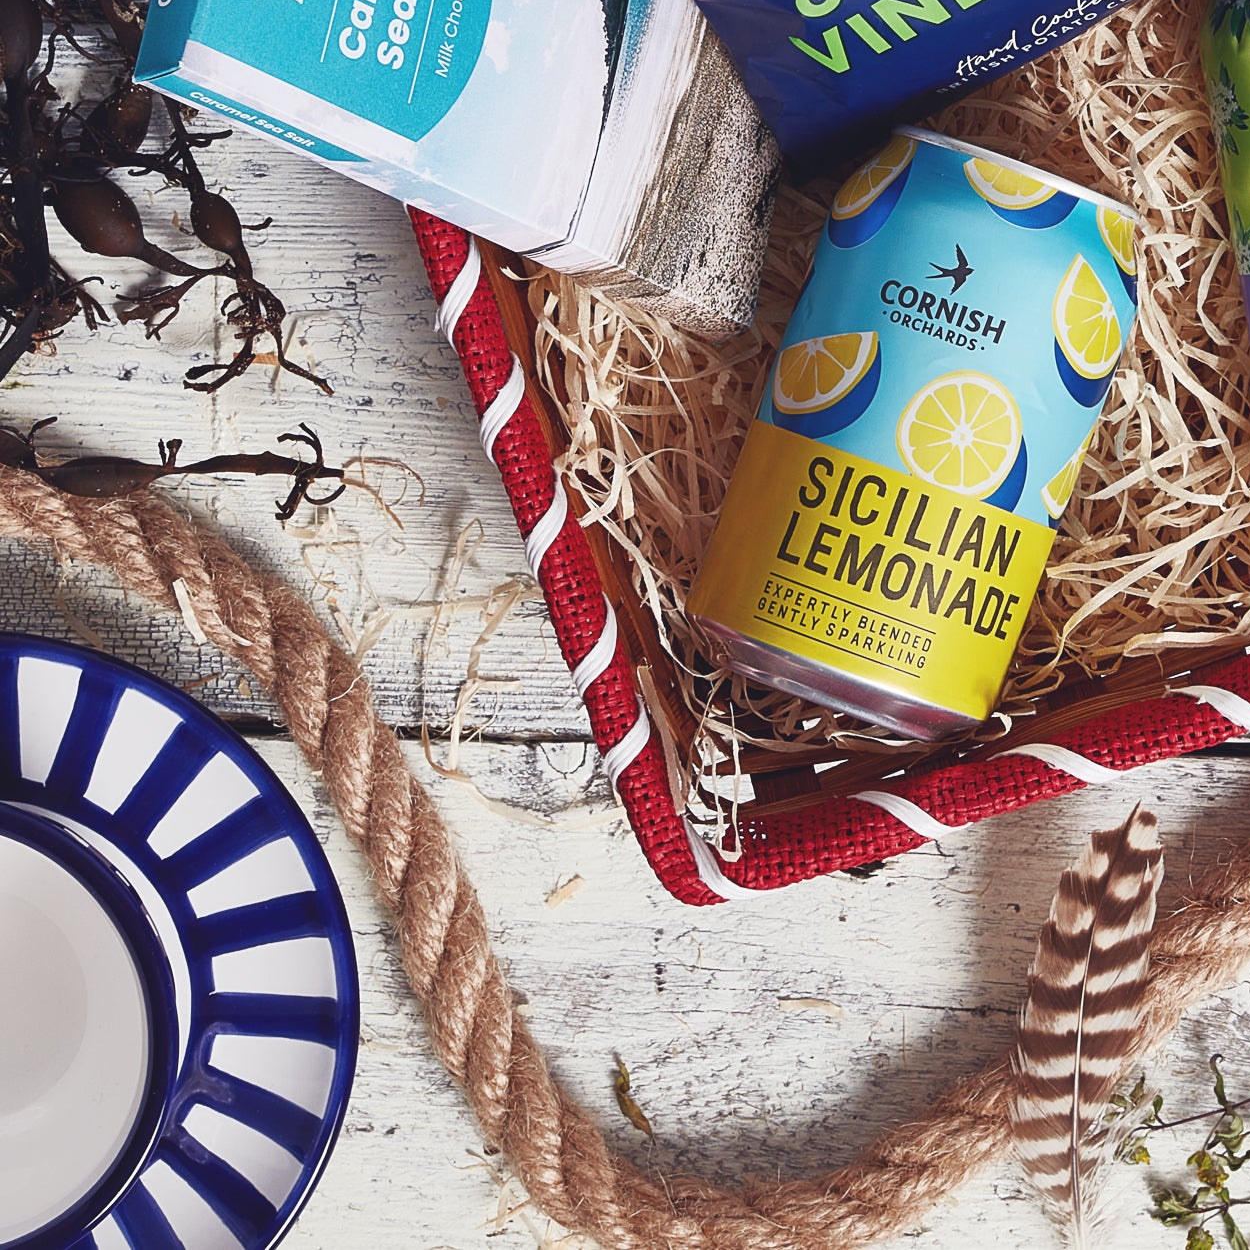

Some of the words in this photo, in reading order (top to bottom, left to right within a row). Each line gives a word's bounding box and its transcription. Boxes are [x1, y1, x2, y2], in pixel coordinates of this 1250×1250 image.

[434, 41, 455, 78] Milk
[955, 30, 1020, 76] Hand
[1021, 12, 1098, 52] POTATO
[189, 91, 257, 122] Caramel
[254, 119, 285, 134] Sea
[283, 131, 316, 148] Salt
[880, 280, 1006, 344] CORNISH
[798, 456, 1022, 577] SICILIAN
[776, 510, 1020, 640] LEMONADE
[757, 597, 820, 631] GENTLY
[825, 623, 926, 669] SPARKLING
[763, 580, 852, 623] EXPERTLY
[858, 616, 933, 653] BLENDED
